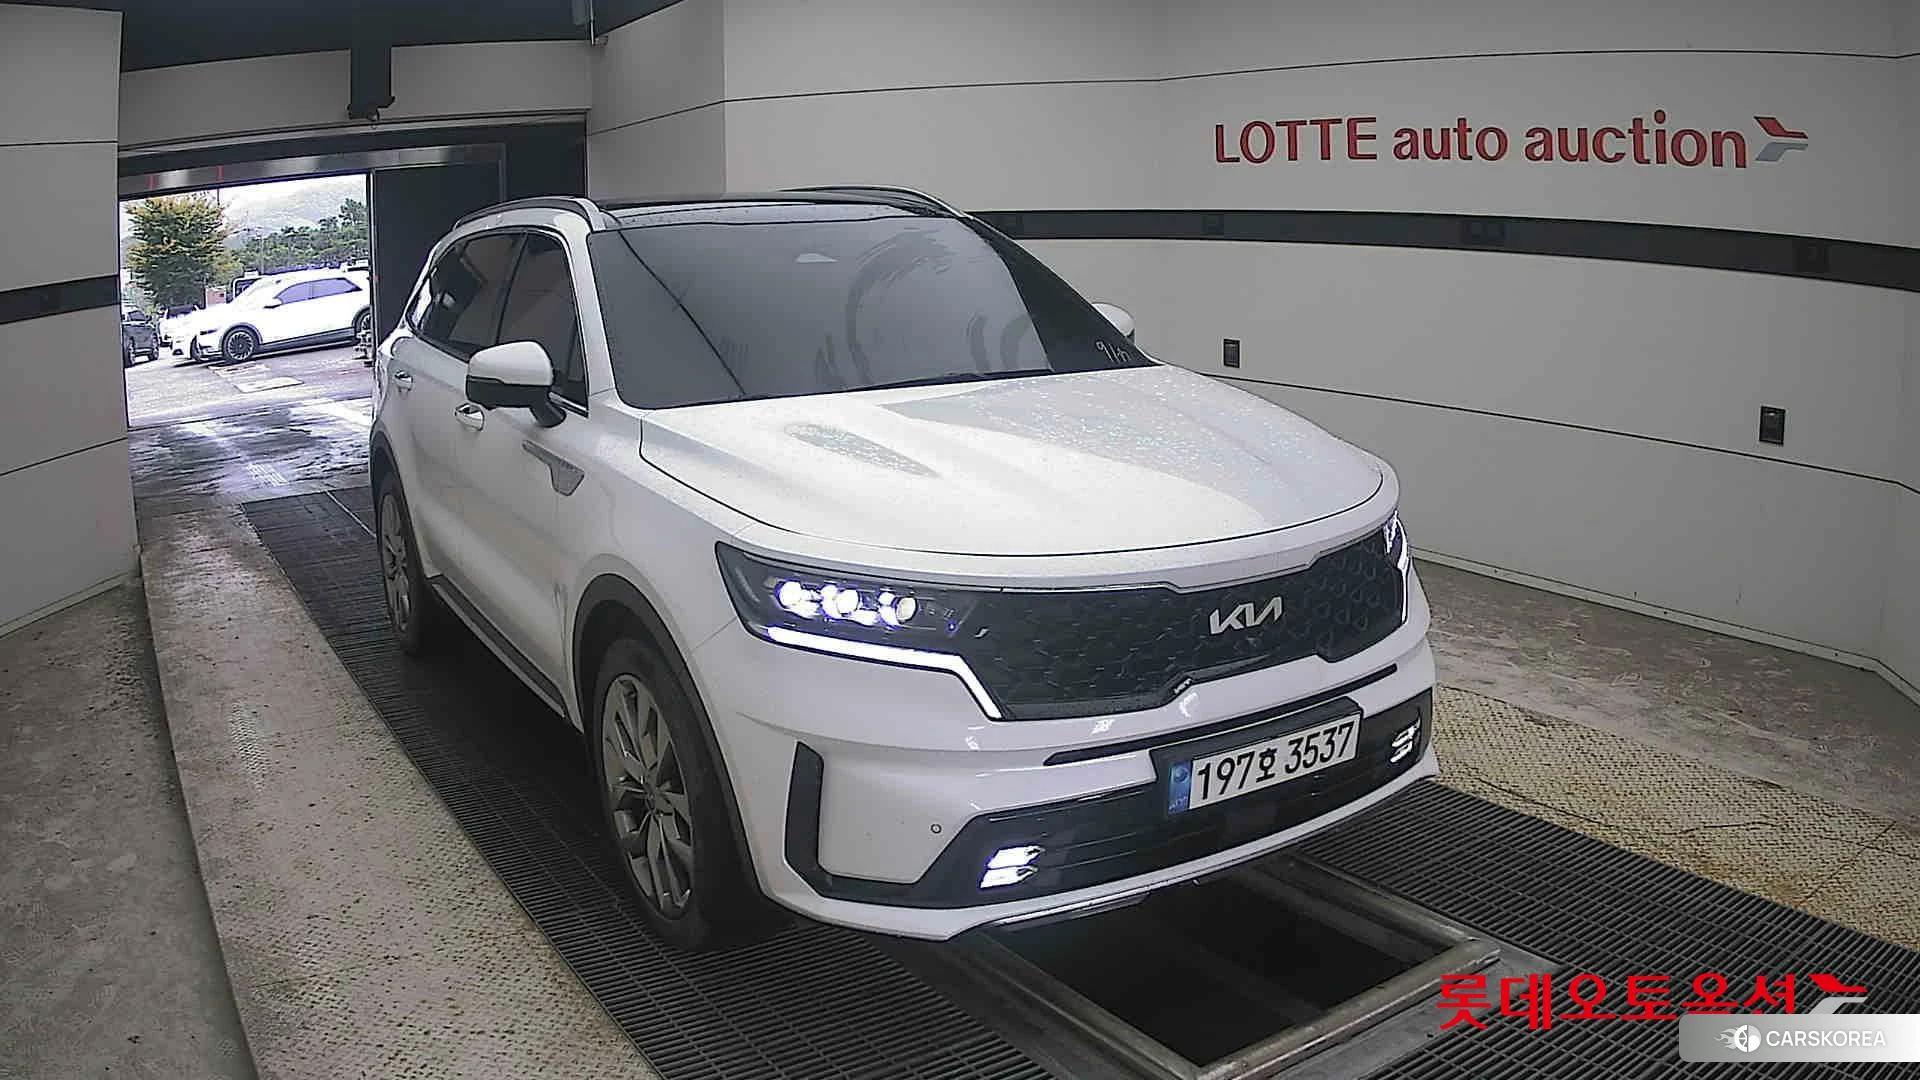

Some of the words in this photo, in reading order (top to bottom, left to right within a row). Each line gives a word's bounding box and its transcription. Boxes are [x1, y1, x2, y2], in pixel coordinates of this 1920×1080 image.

[1215, 117, 1377, 163] LOTTE
[1392, 117, 1508, 162] auto
[1524, 110, 1747, 168] auction
[1209, 596, 1282, 635] KIA
[1198, 748, 1278, 800] 197호
[1285, 720, 1355, 774] 3537
